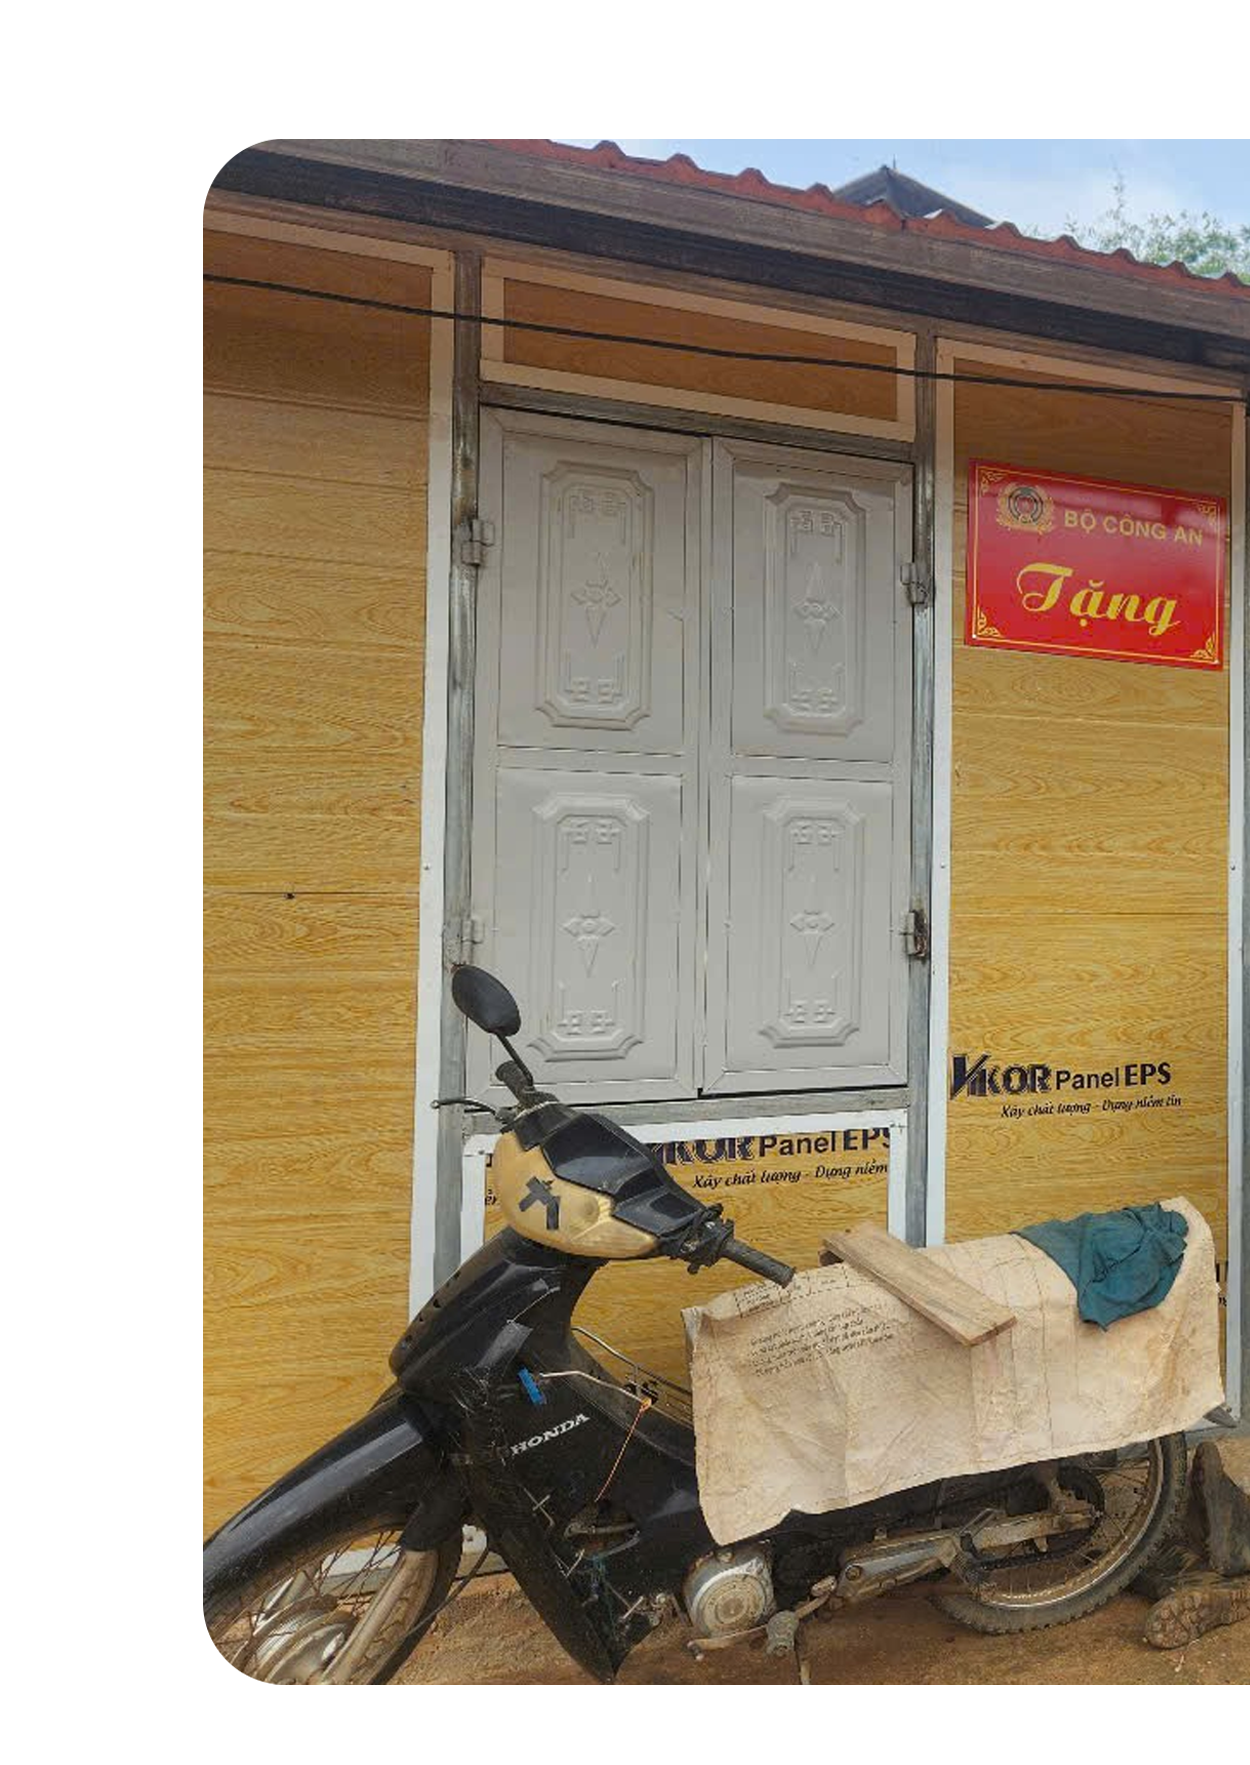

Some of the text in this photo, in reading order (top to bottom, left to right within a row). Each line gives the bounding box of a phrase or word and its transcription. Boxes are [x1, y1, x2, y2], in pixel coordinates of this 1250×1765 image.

[1064, 509, 1202, 546] BỘ CÔNG AN
[1016, 562, 1181, 636] Tặng
[1056, 1067, 1119, 1090] Panel
[1124, 1062, 1172, 1086] EPS
[759, 1131, 836, 1157] Panel
[510, 1413, 590, 1457] HONDA
